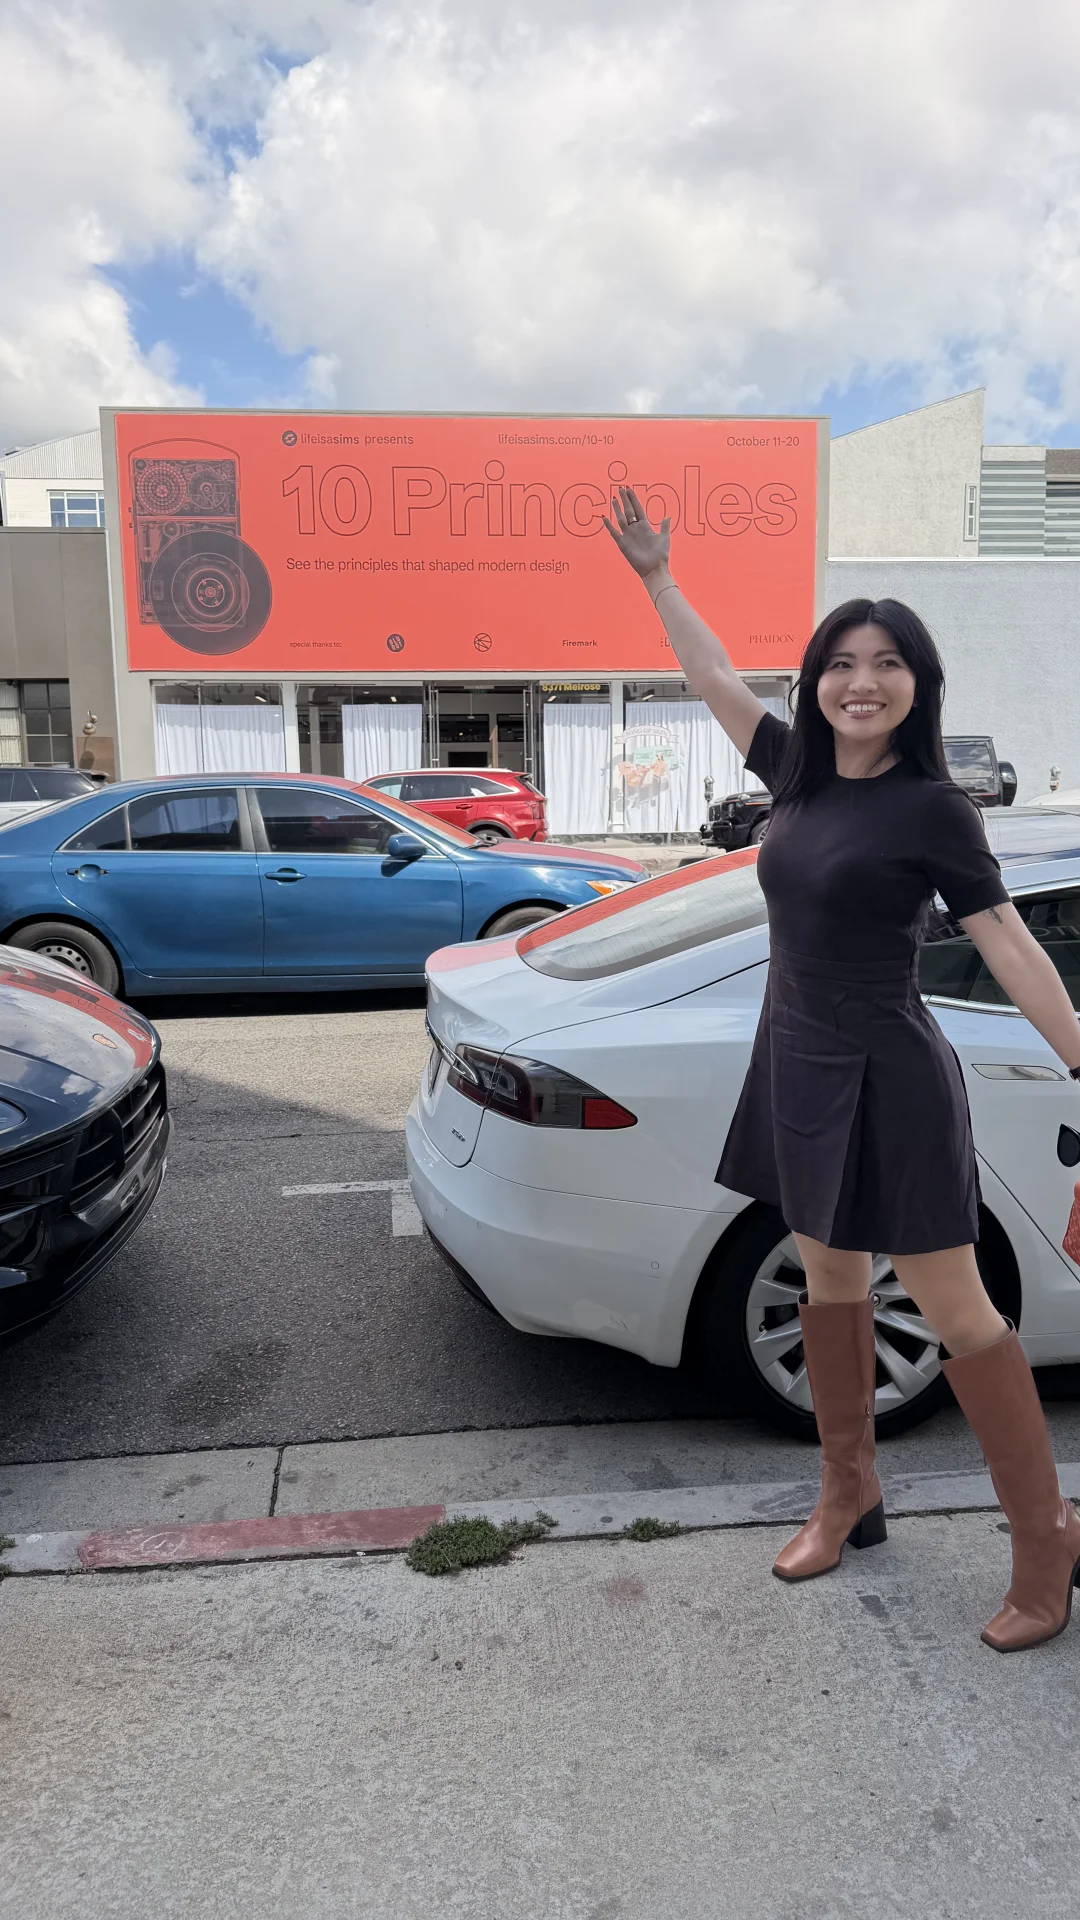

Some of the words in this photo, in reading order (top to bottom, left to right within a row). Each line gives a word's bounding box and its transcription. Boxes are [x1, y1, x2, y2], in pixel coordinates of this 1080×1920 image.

[300, 433, 360, 445] lifeisasims
[364, 434, 414, 446] presents
[498, 433, 615, 446] lifeisasims.com/10-10
[726, 436, 771, 447] October
[772, 436, 800, 447] 11-20
[282, 464, 372, 537] 10
[286, 557, 311, 570] See
[314, 557, 335, 570] the
[338, 557, 399, 573] principles
[402, 558, 426, 571] that
[428, 558, 475, 574] shaped
[478, 558, 527, 572] modern
[529, 559, 570, 575] design
[562, 639, 598, 647] Firemark
[749, 634, 795, 644] PHAIDON
[289, 641, 312, 649] special
[563, 683, 601, 692] Melrose
